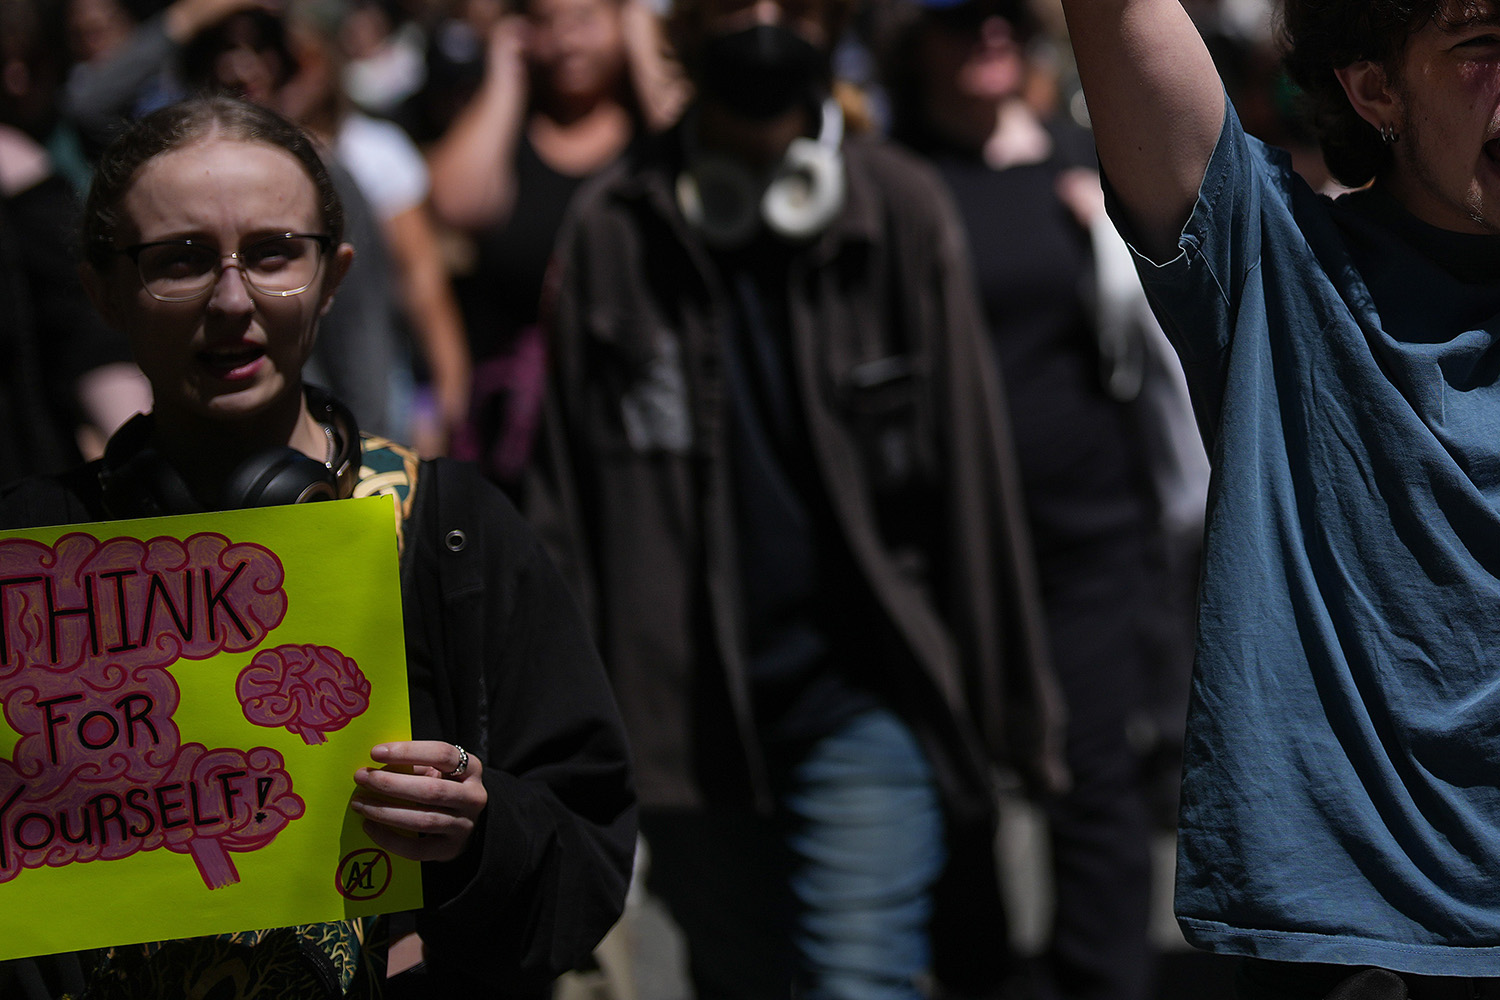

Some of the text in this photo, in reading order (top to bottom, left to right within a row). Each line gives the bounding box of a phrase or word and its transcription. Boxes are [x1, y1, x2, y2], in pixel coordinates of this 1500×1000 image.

[0, 560, 254, 666] THINK
[36, 693, 160, 765] FOR
[0, 770, 274, 870] YOURSELF!
[345, 861, 375, 890] AI
